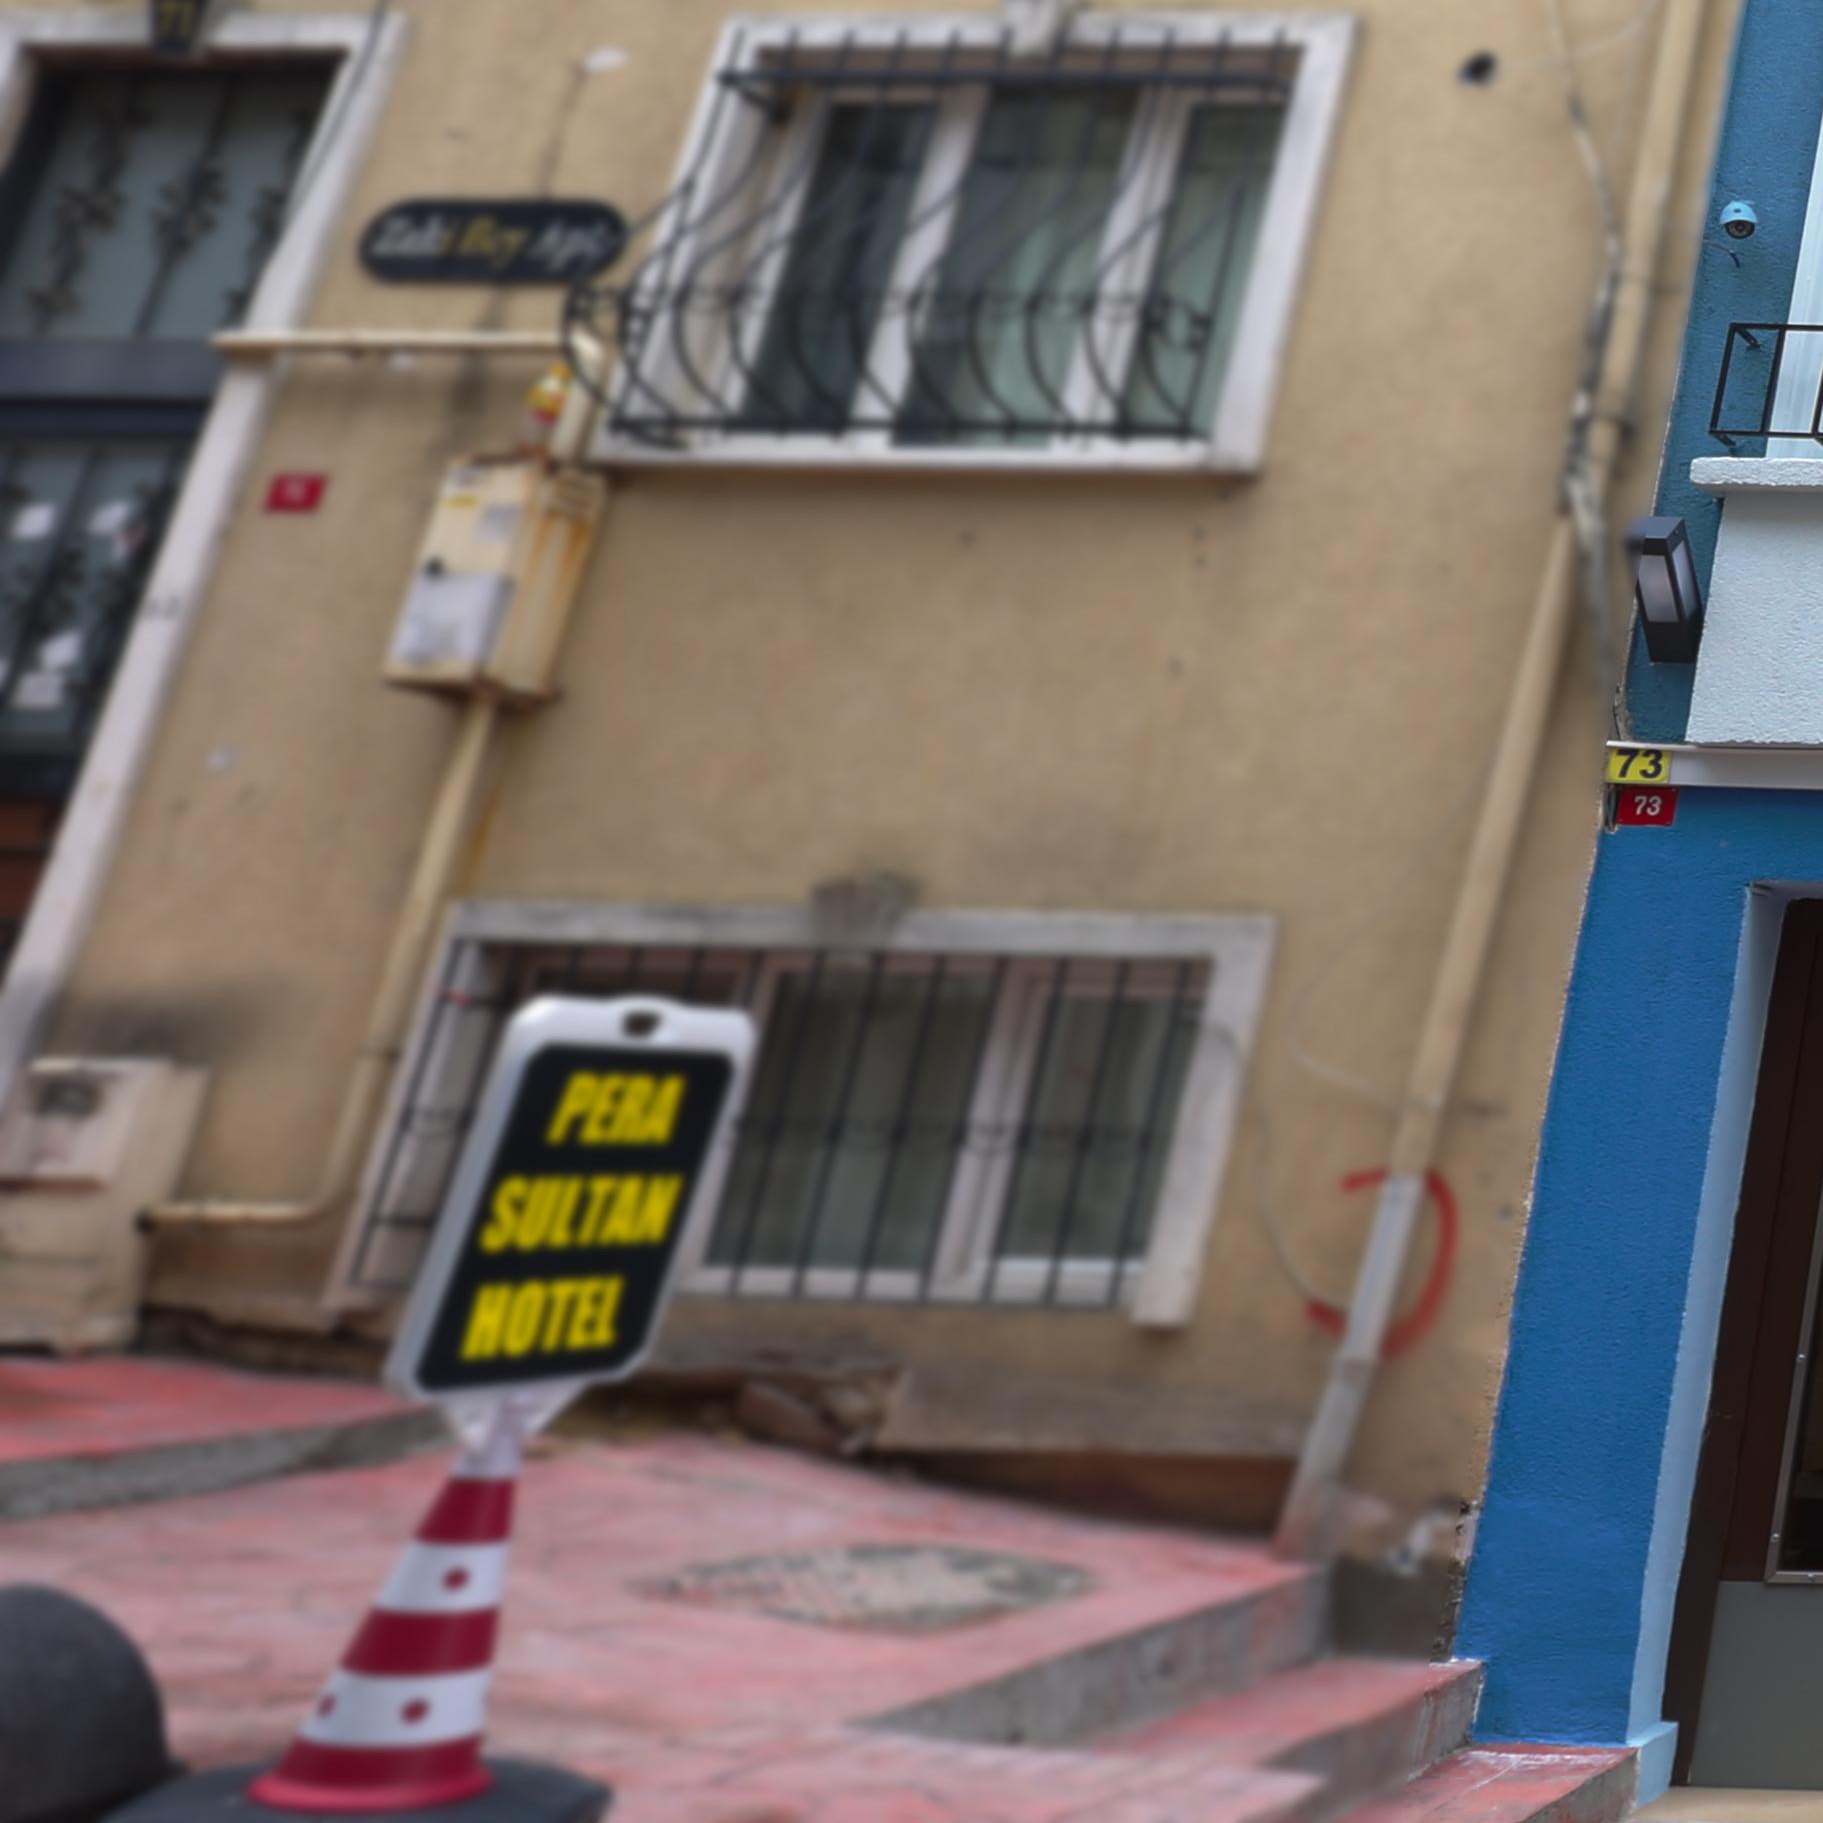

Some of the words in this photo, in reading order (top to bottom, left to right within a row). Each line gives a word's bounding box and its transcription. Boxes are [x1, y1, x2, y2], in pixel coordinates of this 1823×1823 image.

[1616, 747, 1663, 779] 73
[1634, 795, 1662, 816] 73
[545, 1072, 686, 1145] PERA
[480, 1173, 683, 1255] SULTAN
[458, 1274, 624, 1363] HOTEL
